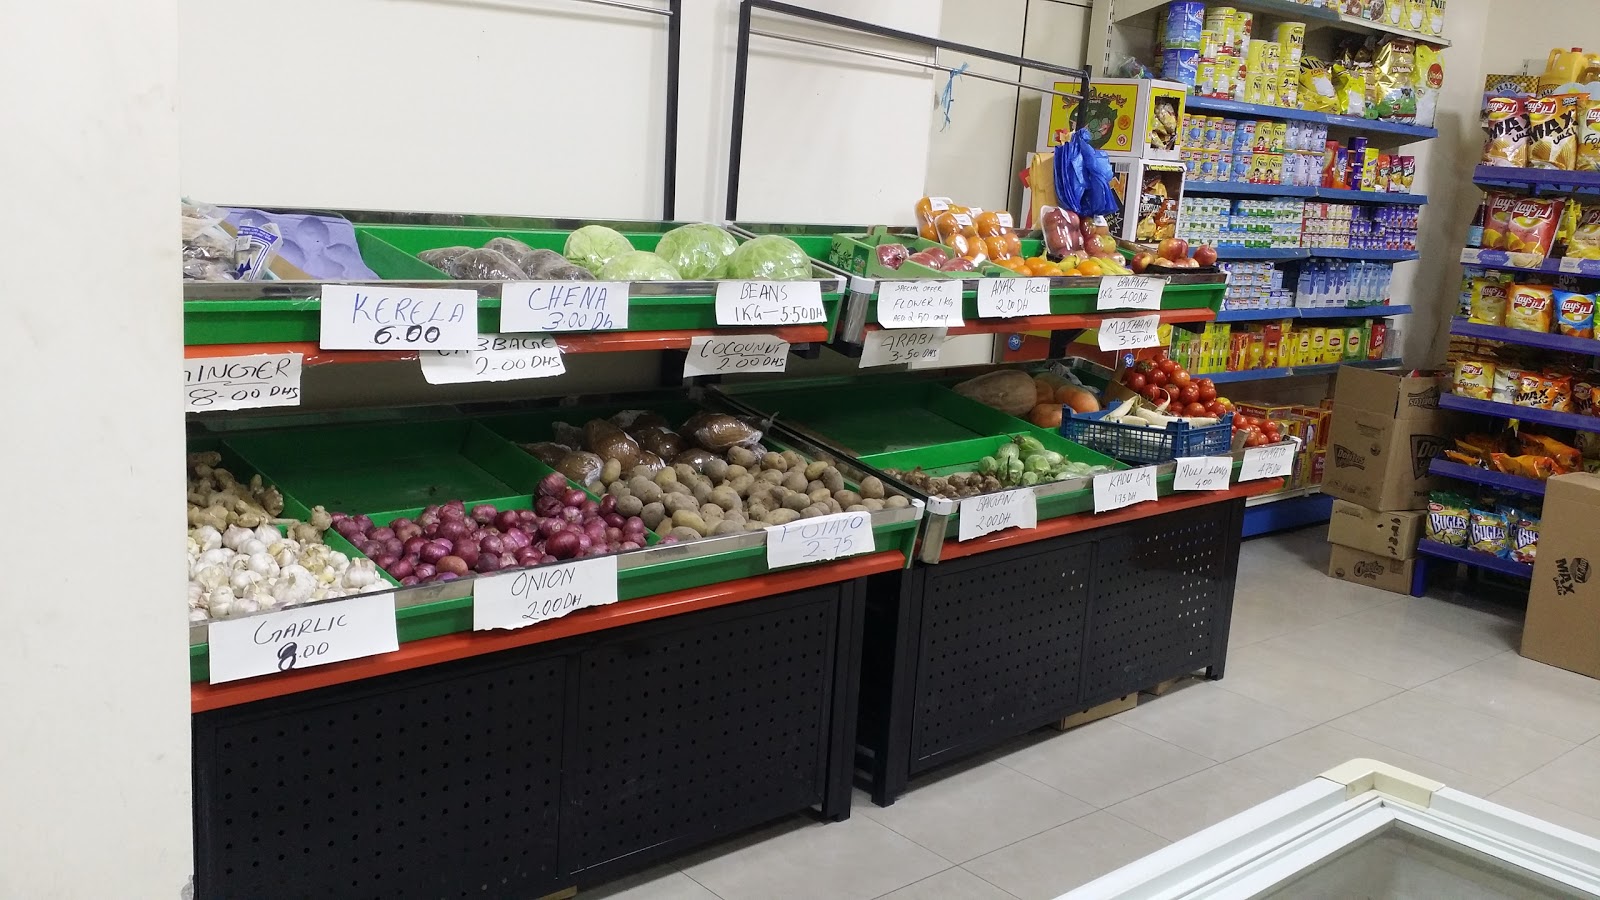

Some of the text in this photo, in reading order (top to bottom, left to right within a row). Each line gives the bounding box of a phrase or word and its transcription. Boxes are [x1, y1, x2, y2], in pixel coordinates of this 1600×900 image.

[1512, 202, 1539, 217] Lay's
[922, 284, 943, 292] OFFER
[1116, 276, 1151, 288] BANANA
[528, 284, 608, 312] CHENA
[740, 282, 789, 303] BEANS
[1514, 294, 1533, 307] Lay's
[352, 293, 465, 325] KERELA
[893, 297, 934, 310] FLOWER
[1561, 300, 1581, 313] Lay's
[373, 324, 441, 345] 6.00
[880, 333, 934, 352] ARABI
[530, 355, 562, 369] DHS
[762, 356, 785, 367] DHS
[269, 385, 300, 400] DHS
[1515, 388, 1549, 402] MAX
[1336, 449, 1366, 465] Doritos
[1179, 464, 1203, 479] MULI
[1108, 472, 1133, 492] KADU
[780, 516, 864, 543] POTATO
[1430, 512, 1467, 535] BUGLES
[1472, 524, 1505, 546] BUGLES
[511, 566, 576, 600] ONION
[253, 613, 348, 645] GARLIC
